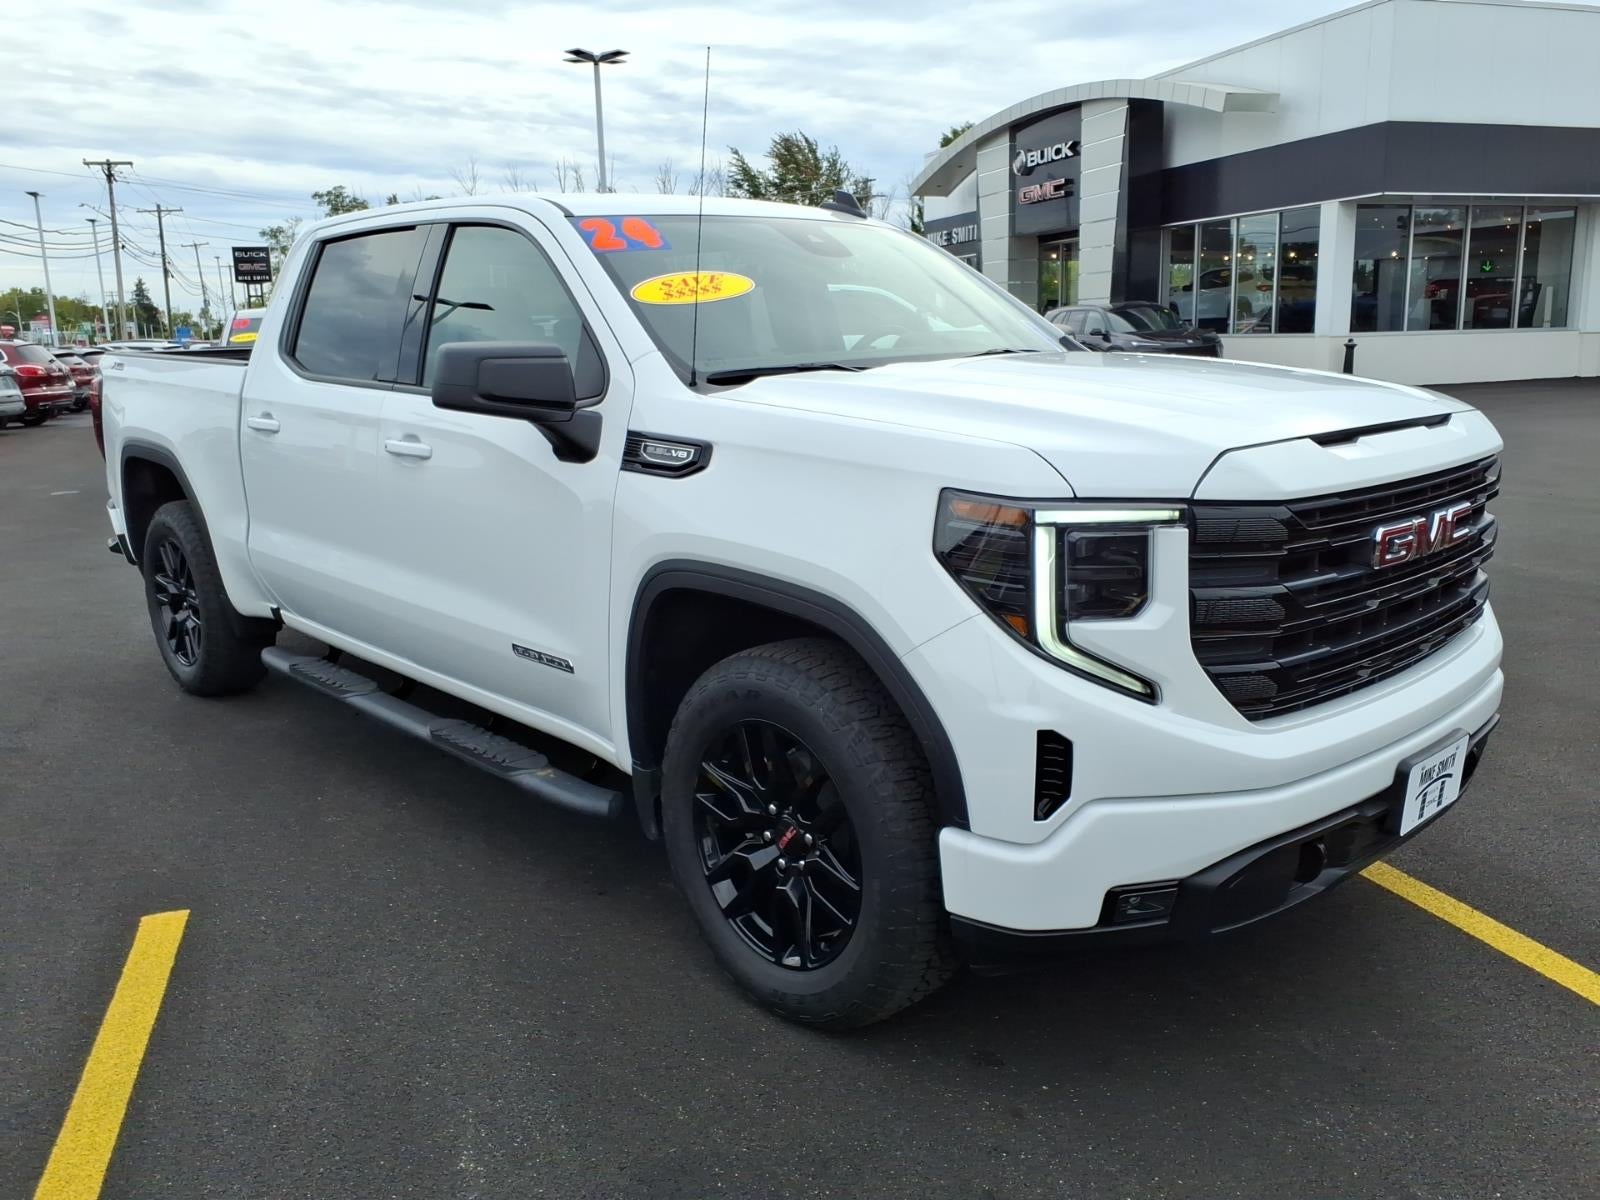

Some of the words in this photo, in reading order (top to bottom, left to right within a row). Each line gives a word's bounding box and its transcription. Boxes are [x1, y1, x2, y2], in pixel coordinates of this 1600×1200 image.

[1027, 140, 1074, 168] BUICK
[1018, 178, 1065, 205] GMC
[238, 263, 267, 271] GMC
[1373, 502, 1472, 570] GMC
